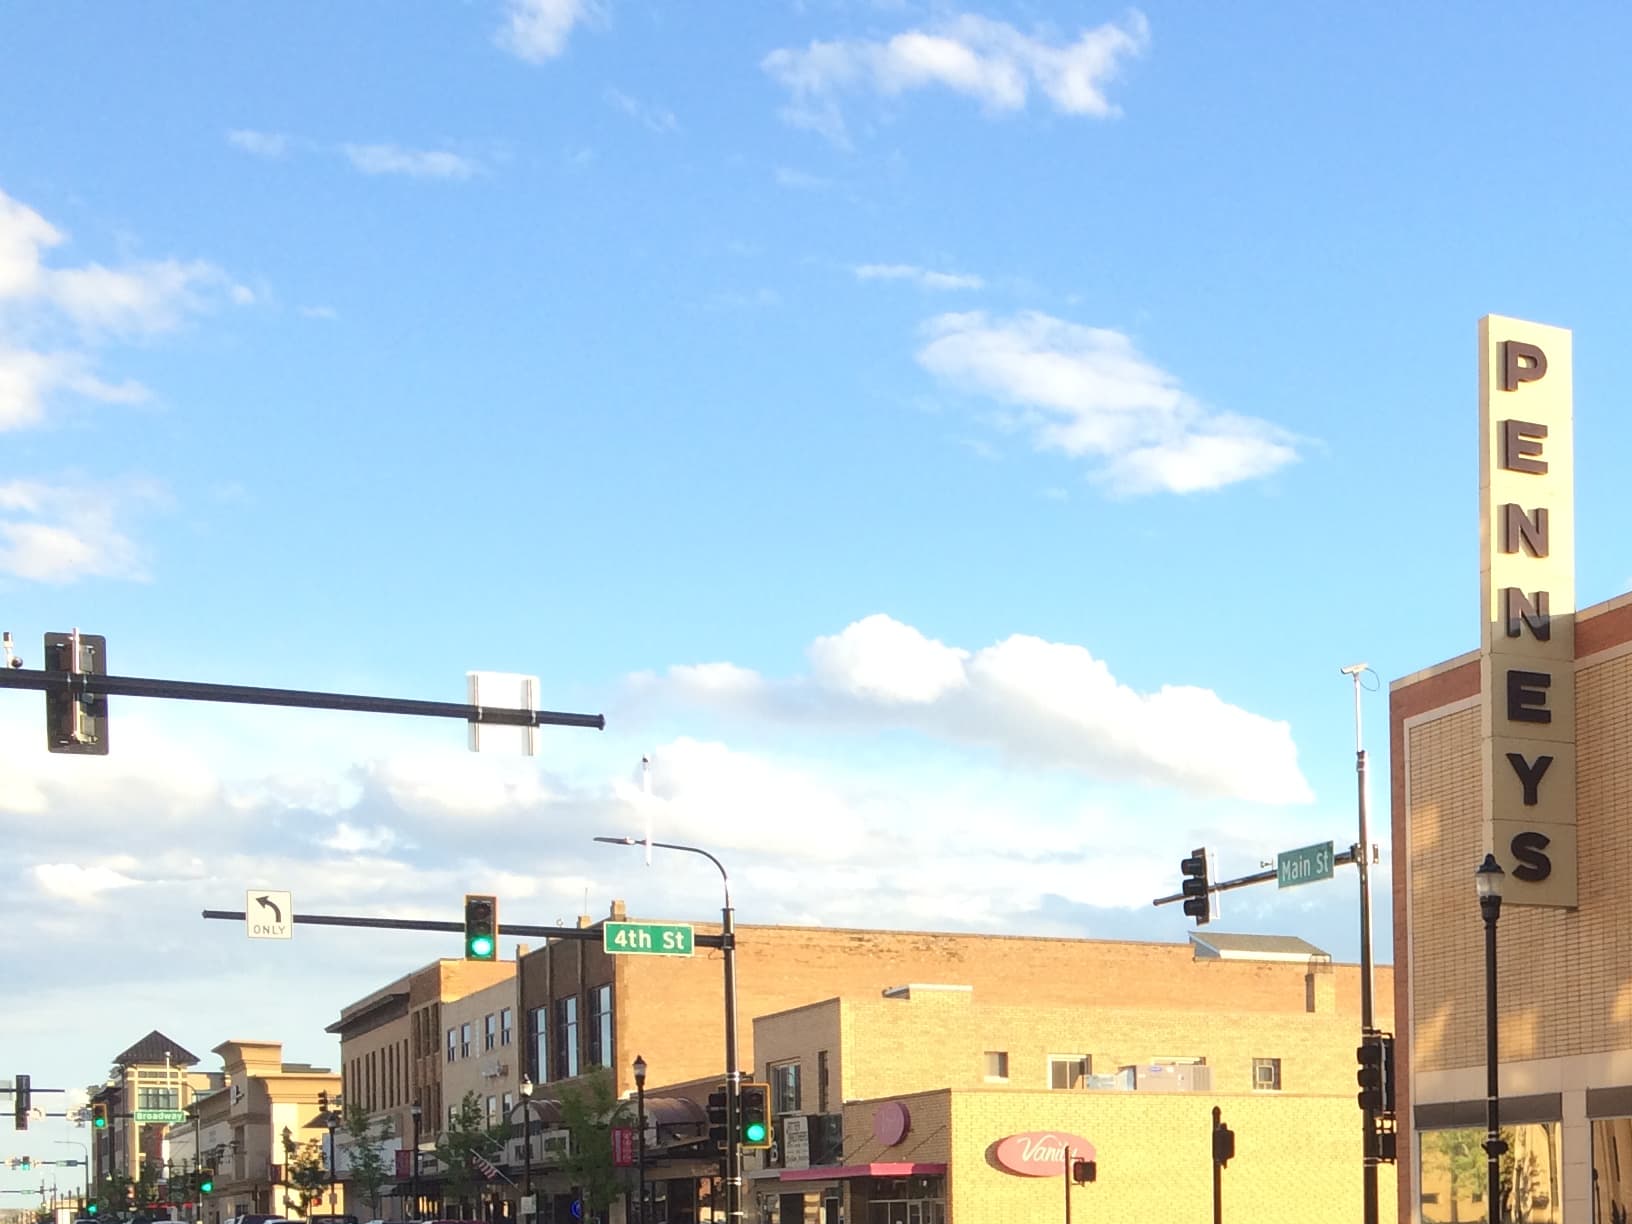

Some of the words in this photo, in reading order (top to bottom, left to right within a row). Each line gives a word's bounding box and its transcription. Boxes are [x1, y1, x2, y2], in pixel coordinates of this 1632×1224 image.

[1505, 340, 1553, 882] PENNEYS
[1281, 854, 1311, 882] Main
[1316, 850, 1329, 874] St
[253, 924, 286, 935] ONLY
[614, 929, 652, 949] 4th
[662, 931, 685, 950] St
[136, 1112, 183, 1121] Broadway
